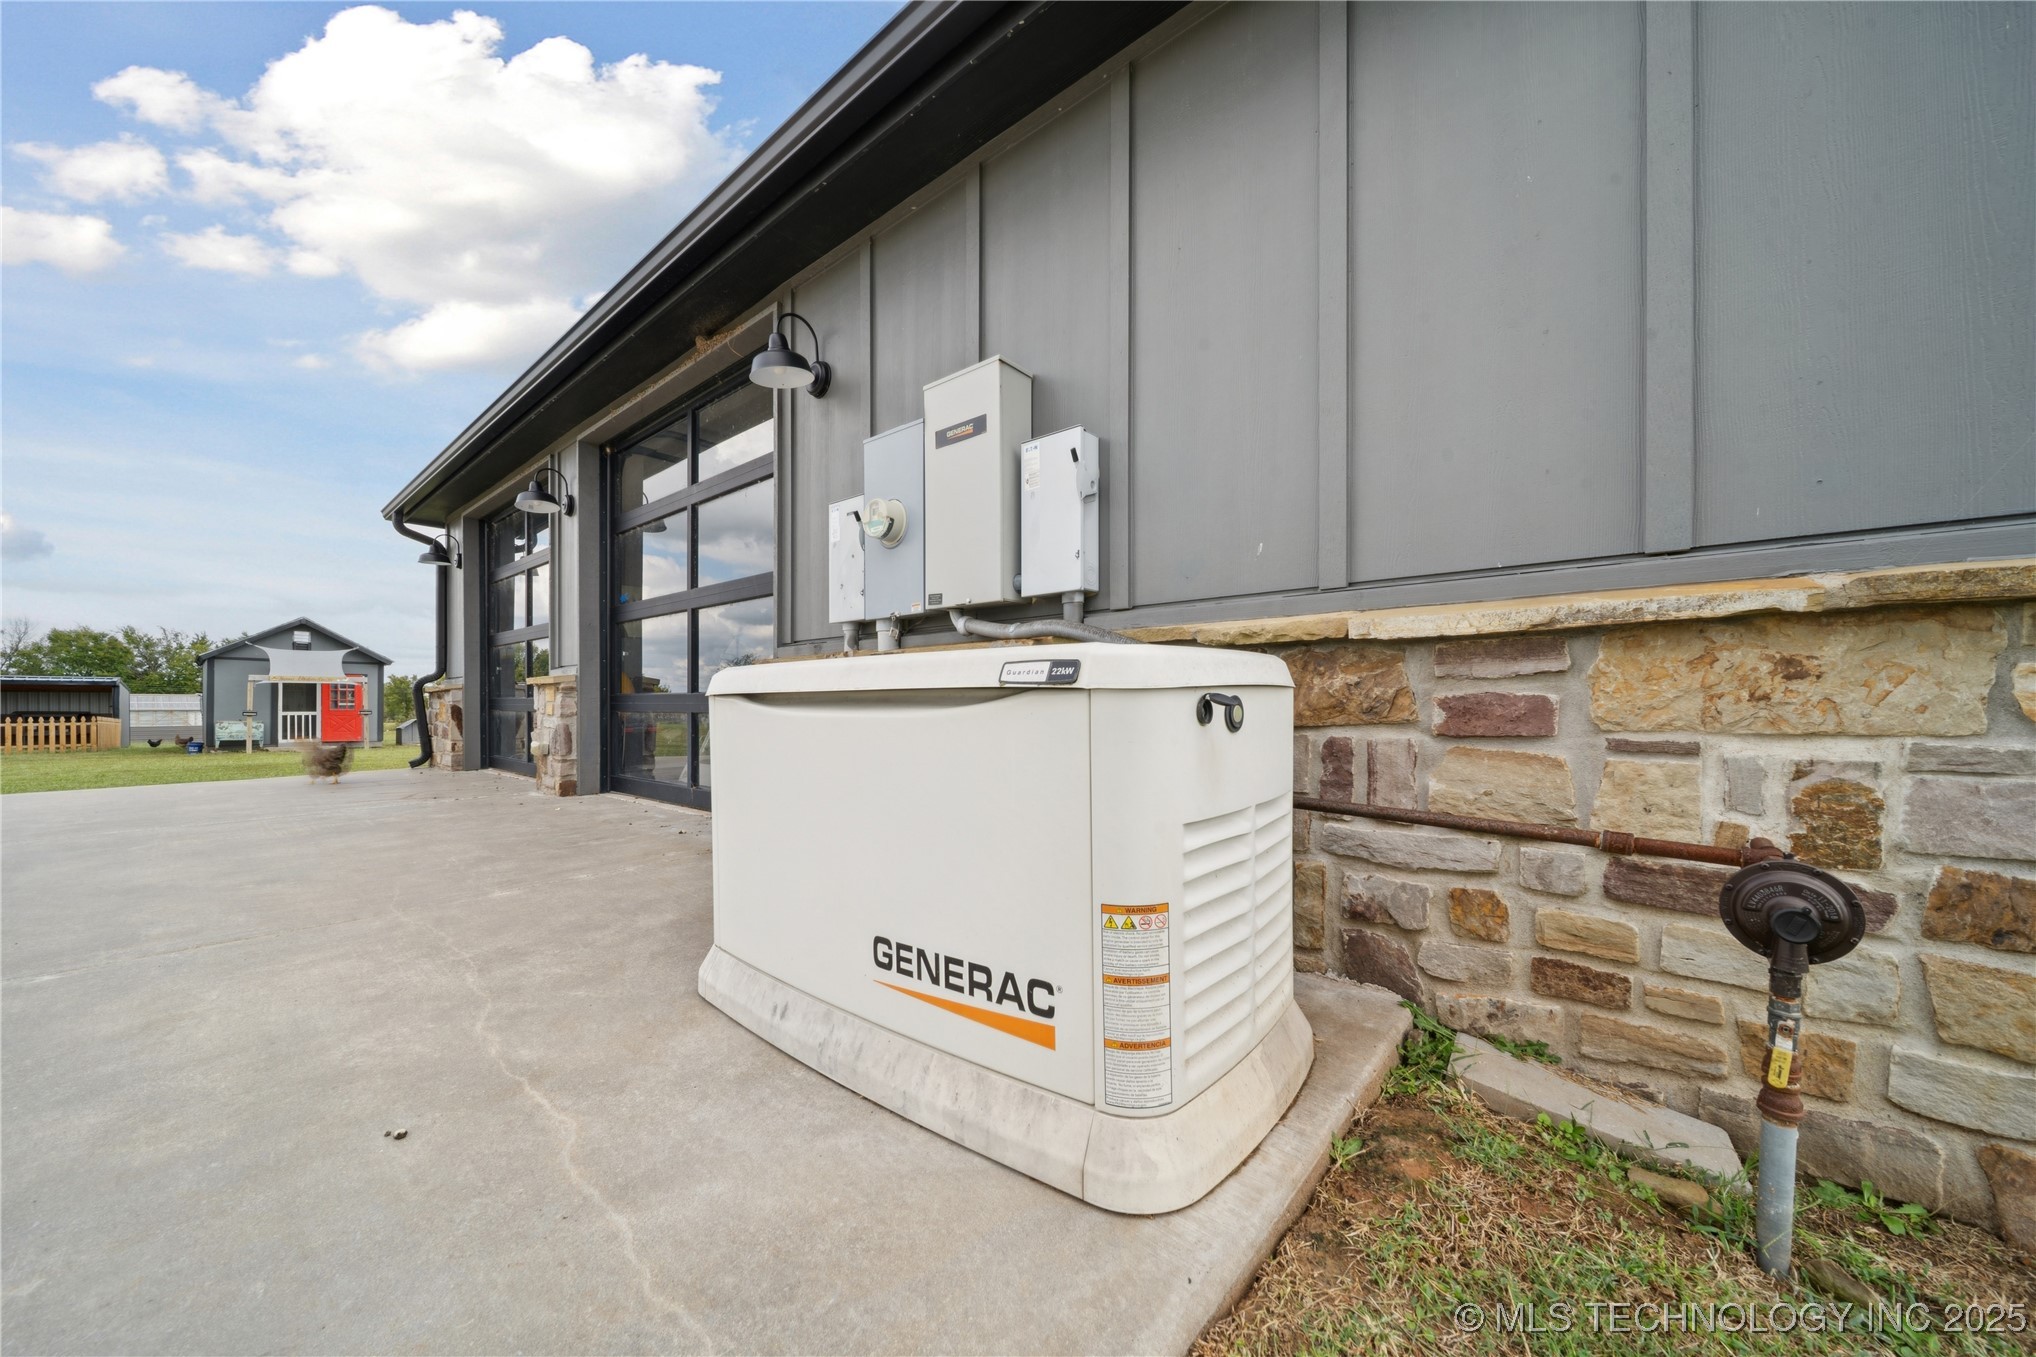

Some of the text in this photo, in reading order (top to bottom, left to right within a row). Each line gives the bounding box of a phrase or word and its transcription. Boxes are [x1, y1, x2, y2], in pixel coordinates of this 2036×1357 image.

[946, 423, 974, 438] GENERAC
[1006, 667, 1075, 677] Guardian 22kW
[1125, 906, 1157, 914] WARNING
[1113, 976, 1167, 985] AVERTISSEMENT
[1119, 1041, 1166, 1049] ADVERTENCIA
